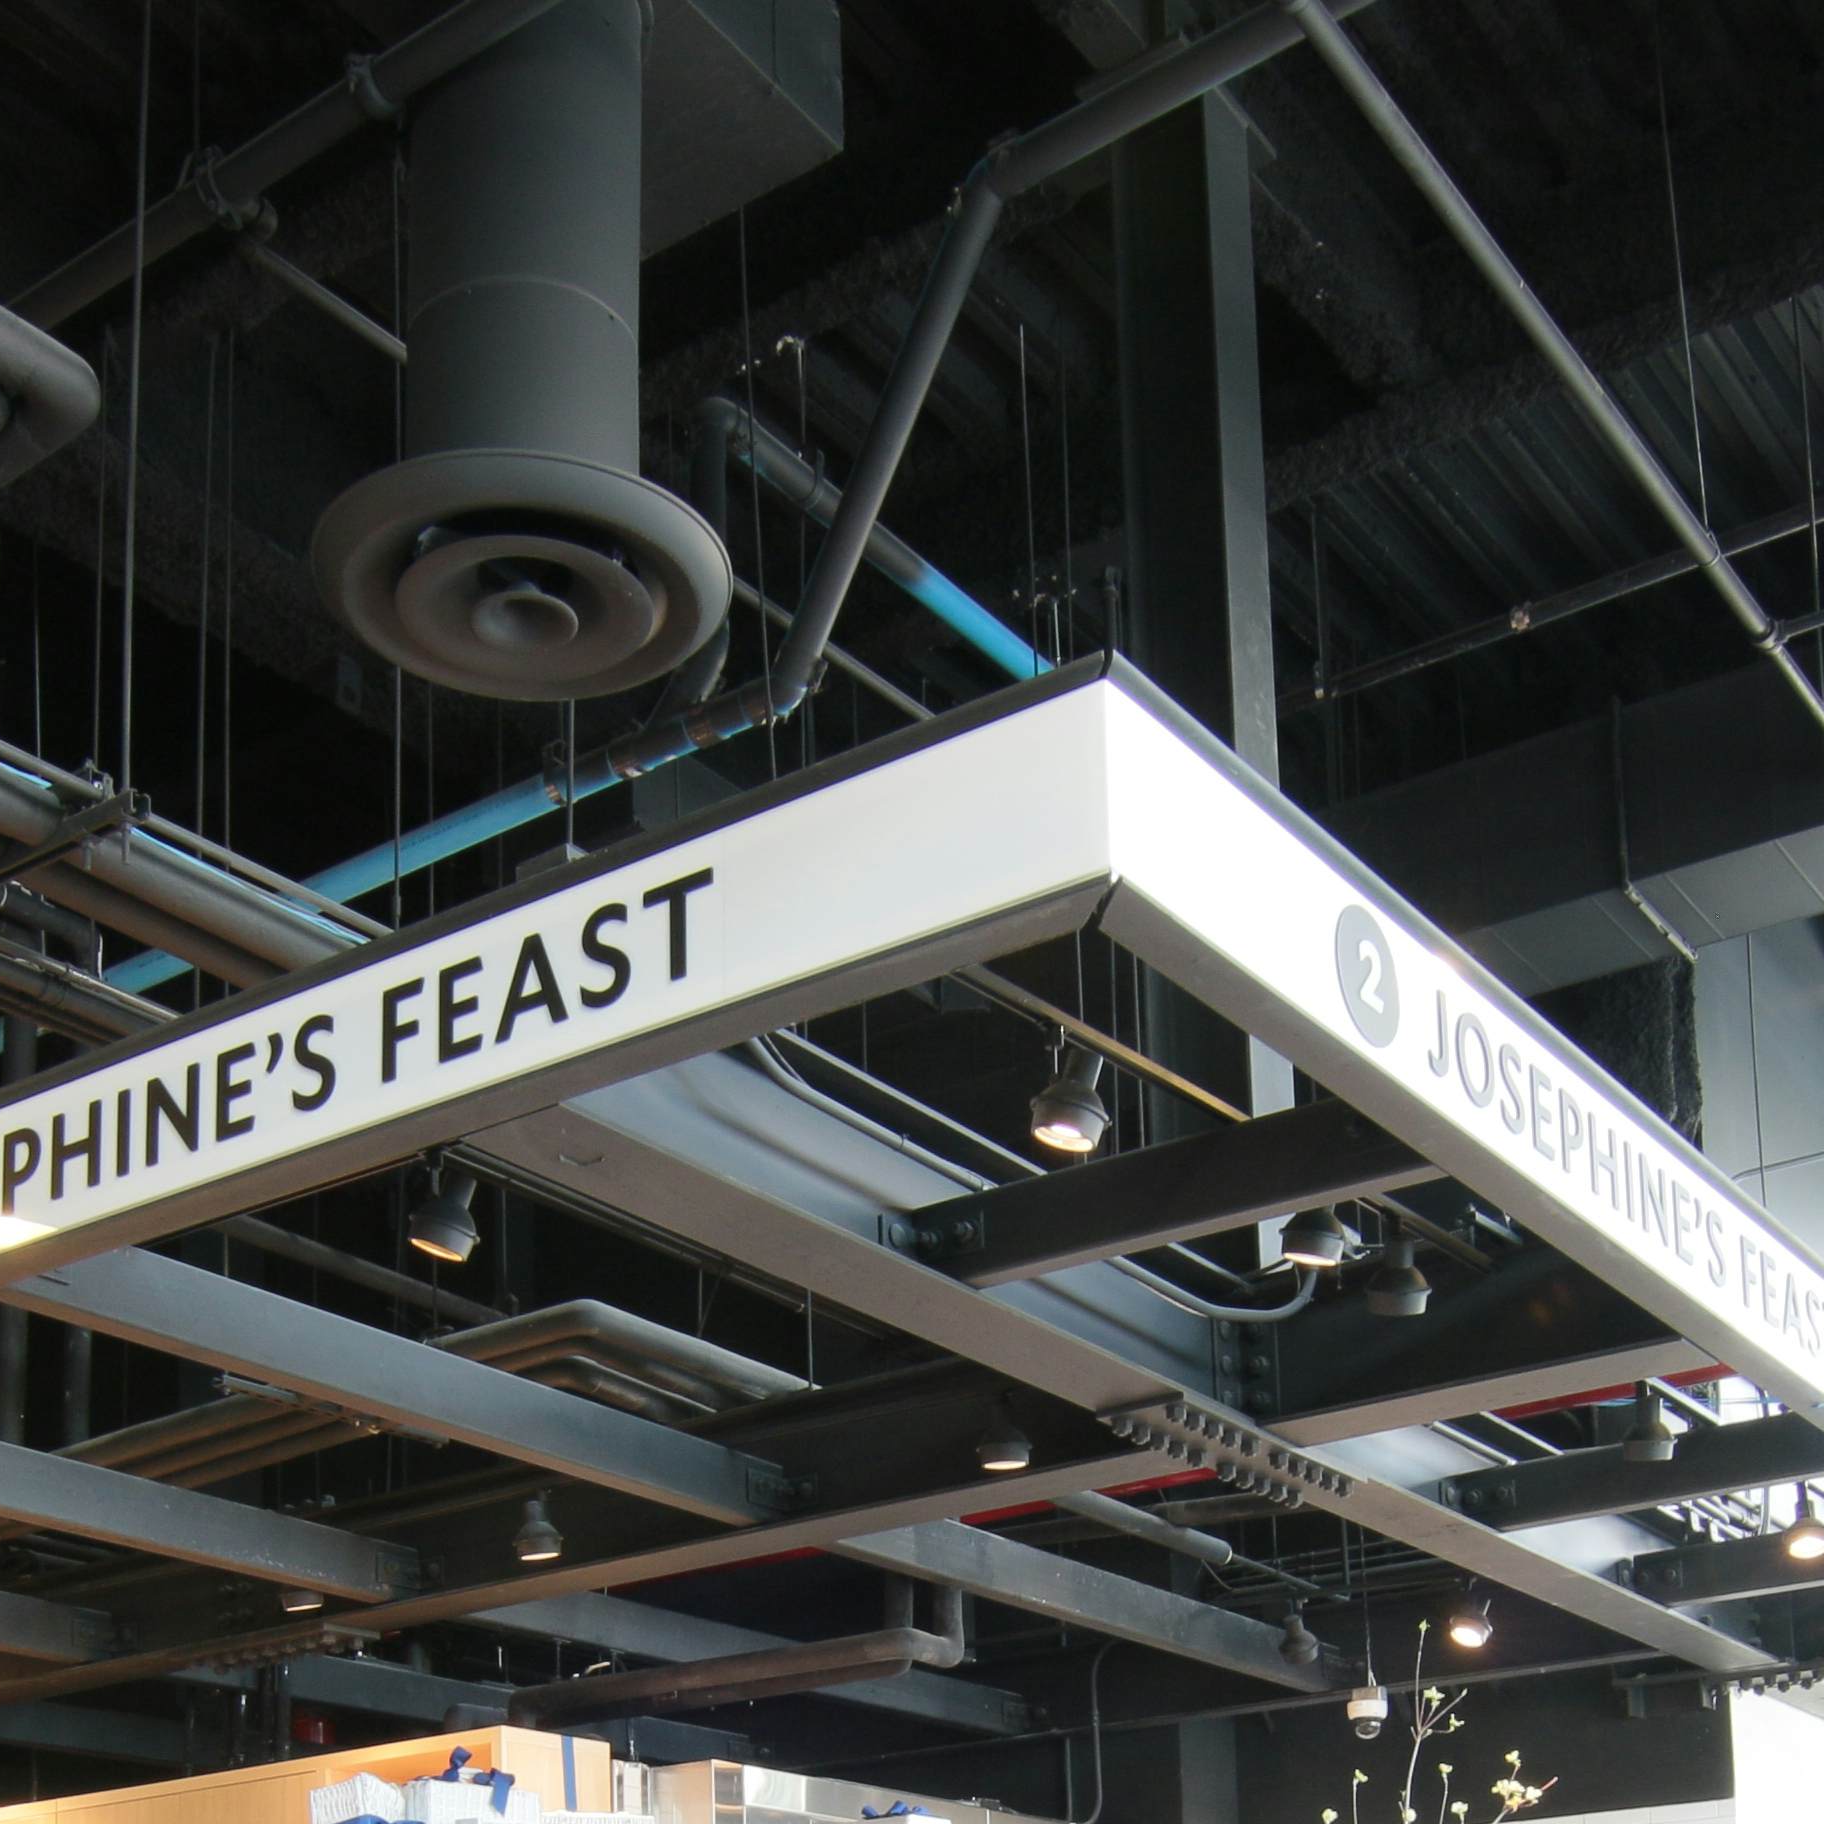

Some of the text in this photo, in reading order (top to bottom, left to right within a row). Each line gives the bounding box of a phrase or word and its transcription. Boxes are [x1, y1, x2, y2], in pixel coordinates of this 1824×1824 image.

[380, 866, 715, 1083] FEAST
[1357, 938, 1386, 1015] 2
[1427, 989, 1728, 1288] JOSEPHINE'S
